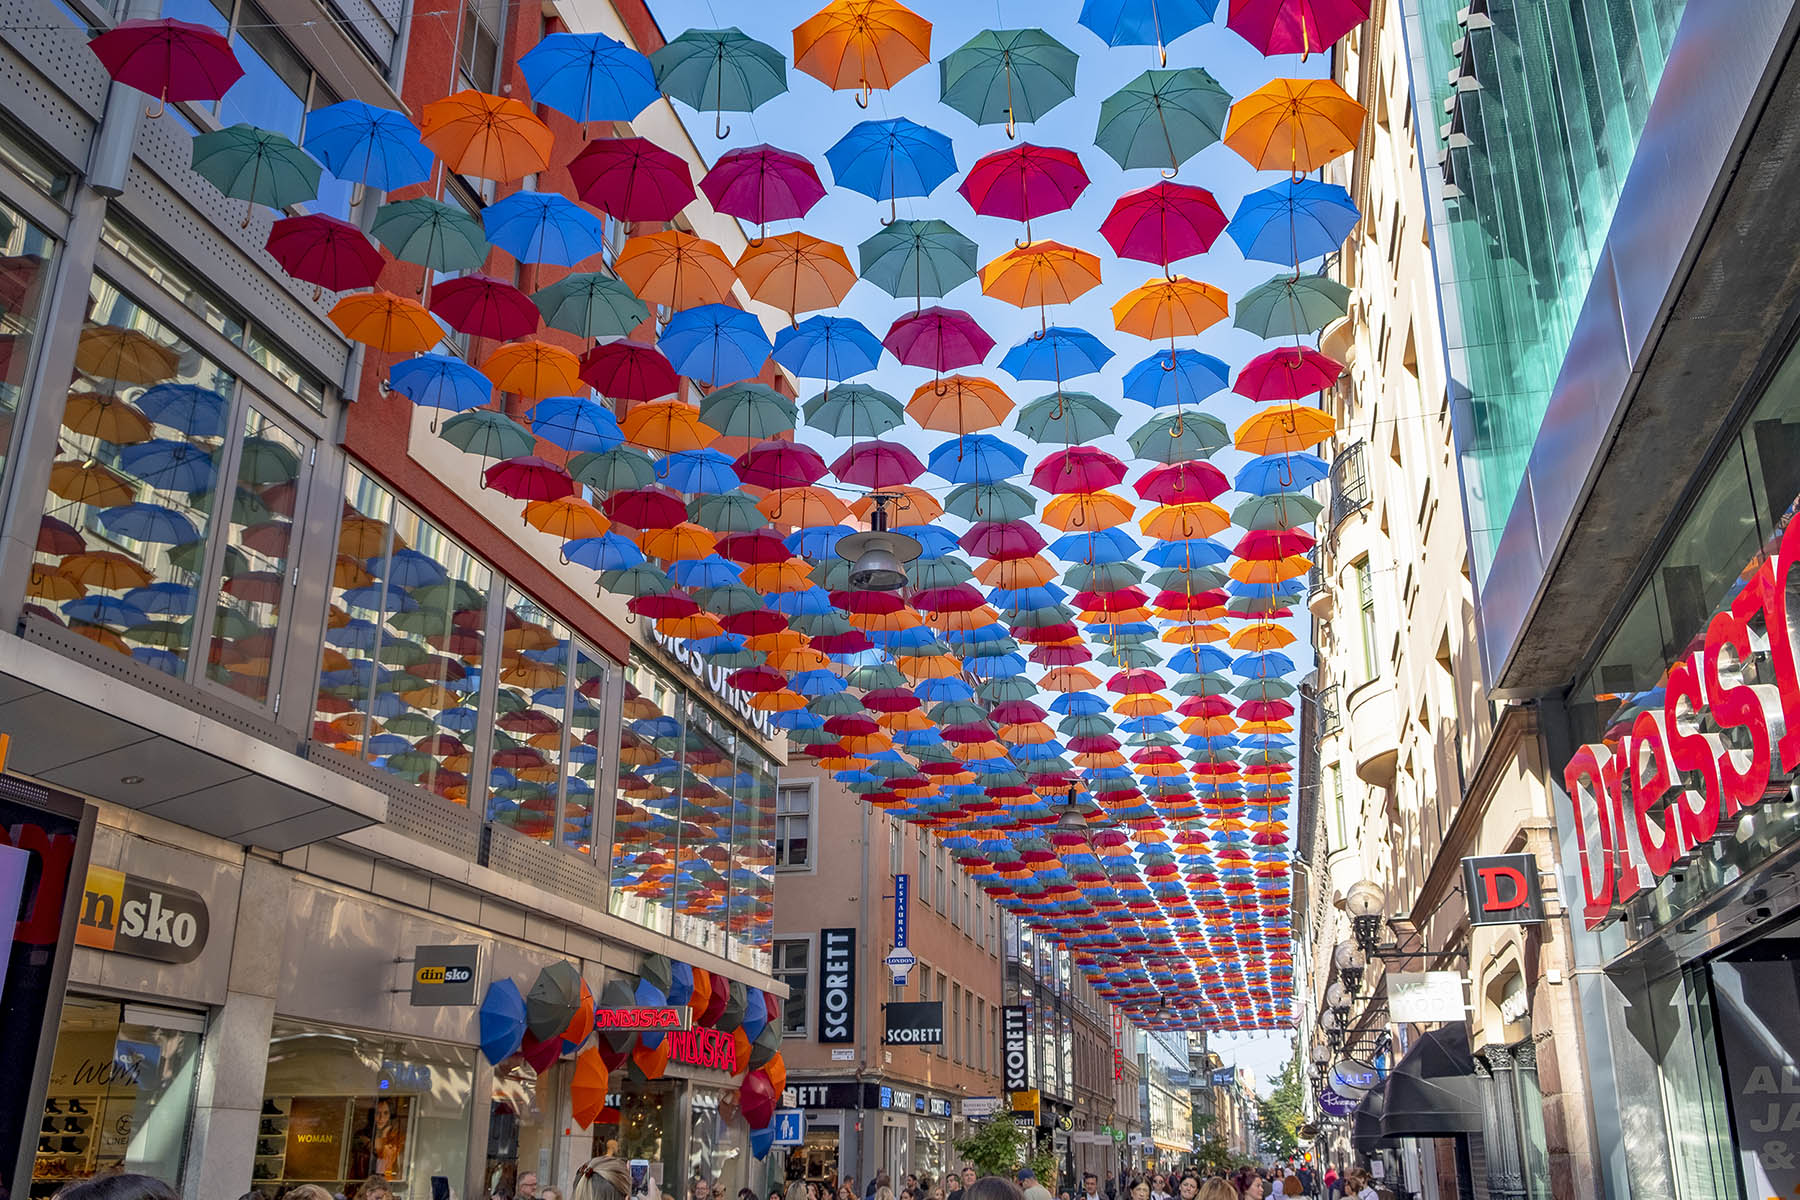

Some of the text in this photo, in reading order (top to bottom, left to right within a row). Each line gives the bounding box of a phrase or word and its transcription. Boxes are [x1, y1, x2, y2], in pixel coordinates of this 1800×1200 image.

[1564, 510, 1800, 932] Dress
[897, 876, 905, 947] RESTAURANG
[421, 968, 470, 981] dinsko
[825, 932, 849, 1038] SCORETT
[888, 1029, 941, 1042] SCORETT
[1006, 1009, 1025, 1089] SCORETT
[1335, 1073, 1373, 1085] SALT
[297, 1134, 333, 1143] WOMAN
